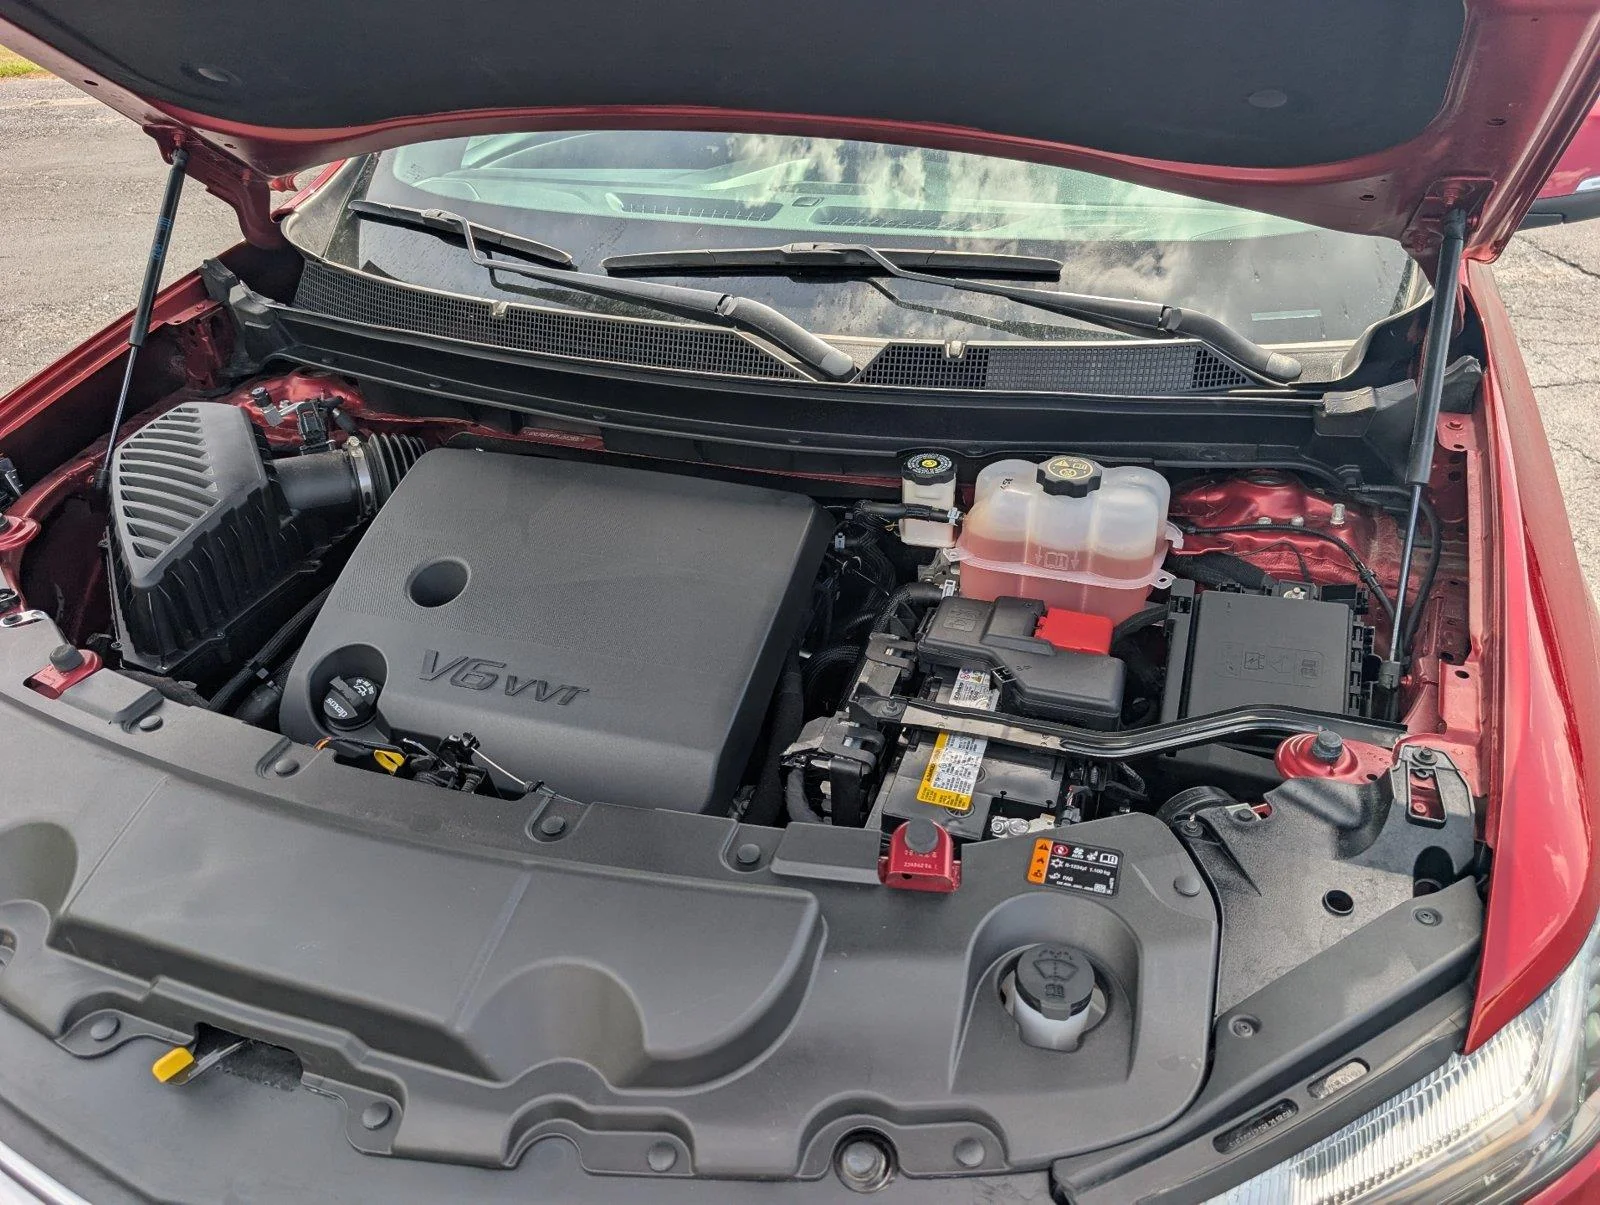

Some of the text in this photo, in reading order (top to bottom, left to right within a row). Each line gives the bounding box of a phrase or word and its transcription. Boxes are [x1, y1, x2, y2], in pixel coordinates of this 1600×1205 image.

[419, 649, 590, 706] V6 VVT
[325, 697, 348, 718] dexos
